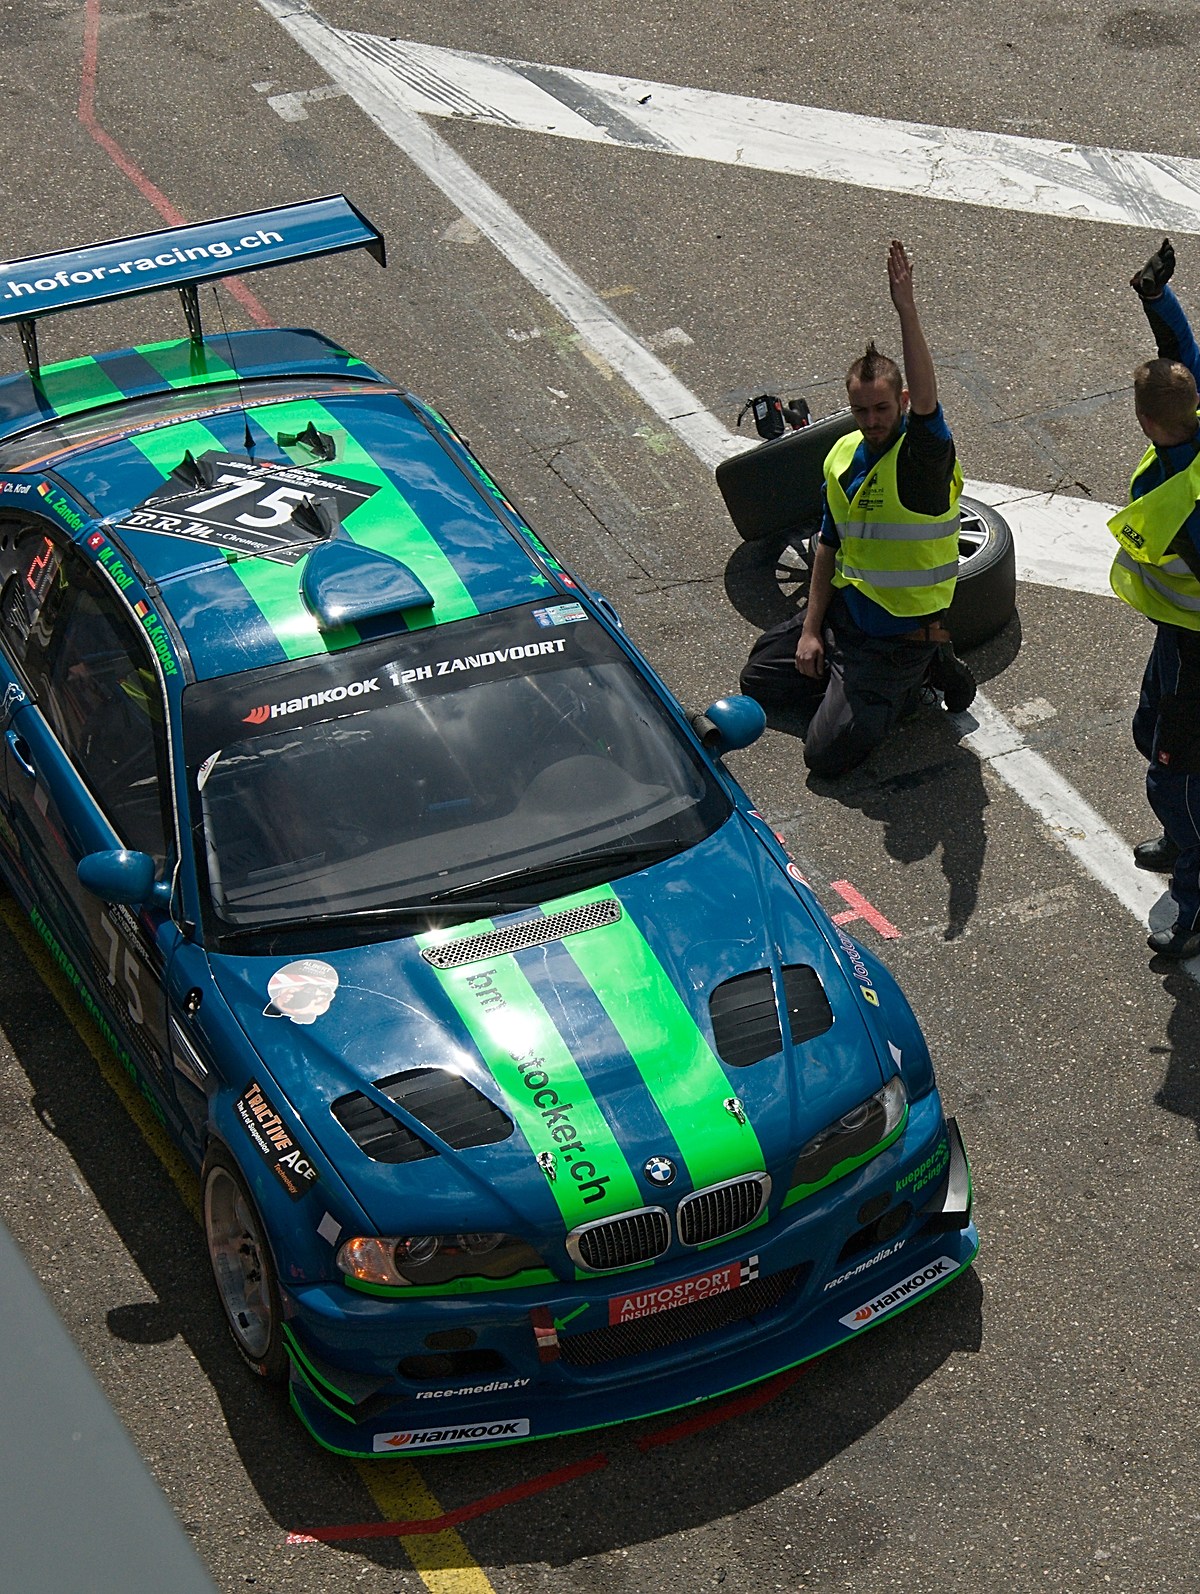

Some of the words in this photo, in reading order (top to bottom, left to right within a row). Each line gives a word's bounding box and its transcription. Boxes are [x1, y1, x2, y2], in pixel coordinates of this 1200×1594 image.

[3, 230, 284, 299] .hofor-racing.ch
[44, 490, 53, 502] L.
[53, 497, 84, 531] Zander
[184, 474, 315, 528] 75
[98, 547, 109, 564] M.
[109, 561, 135, 590] Kroll
[389, 664, 432, 687] 12H
[436, 638, 567, 677] ZANDVOORT
[100, 912, 144, 1025] 75
[244, 1083, 293, 1151] TRACTIVE
[278, 1149, 316, 1180] ACE
[248, 1122, 270, 1154] Suspension
[274, 1163, 298, 1194] Technology
[822, 1239, 906, 1292] race-media.tv
[620, 1270, 731, 1313] AUTOSPORT
[620, 1283, 731, 1323] INSURANCE.COM
[415, 1377, 531, 1400] race-media.tv
